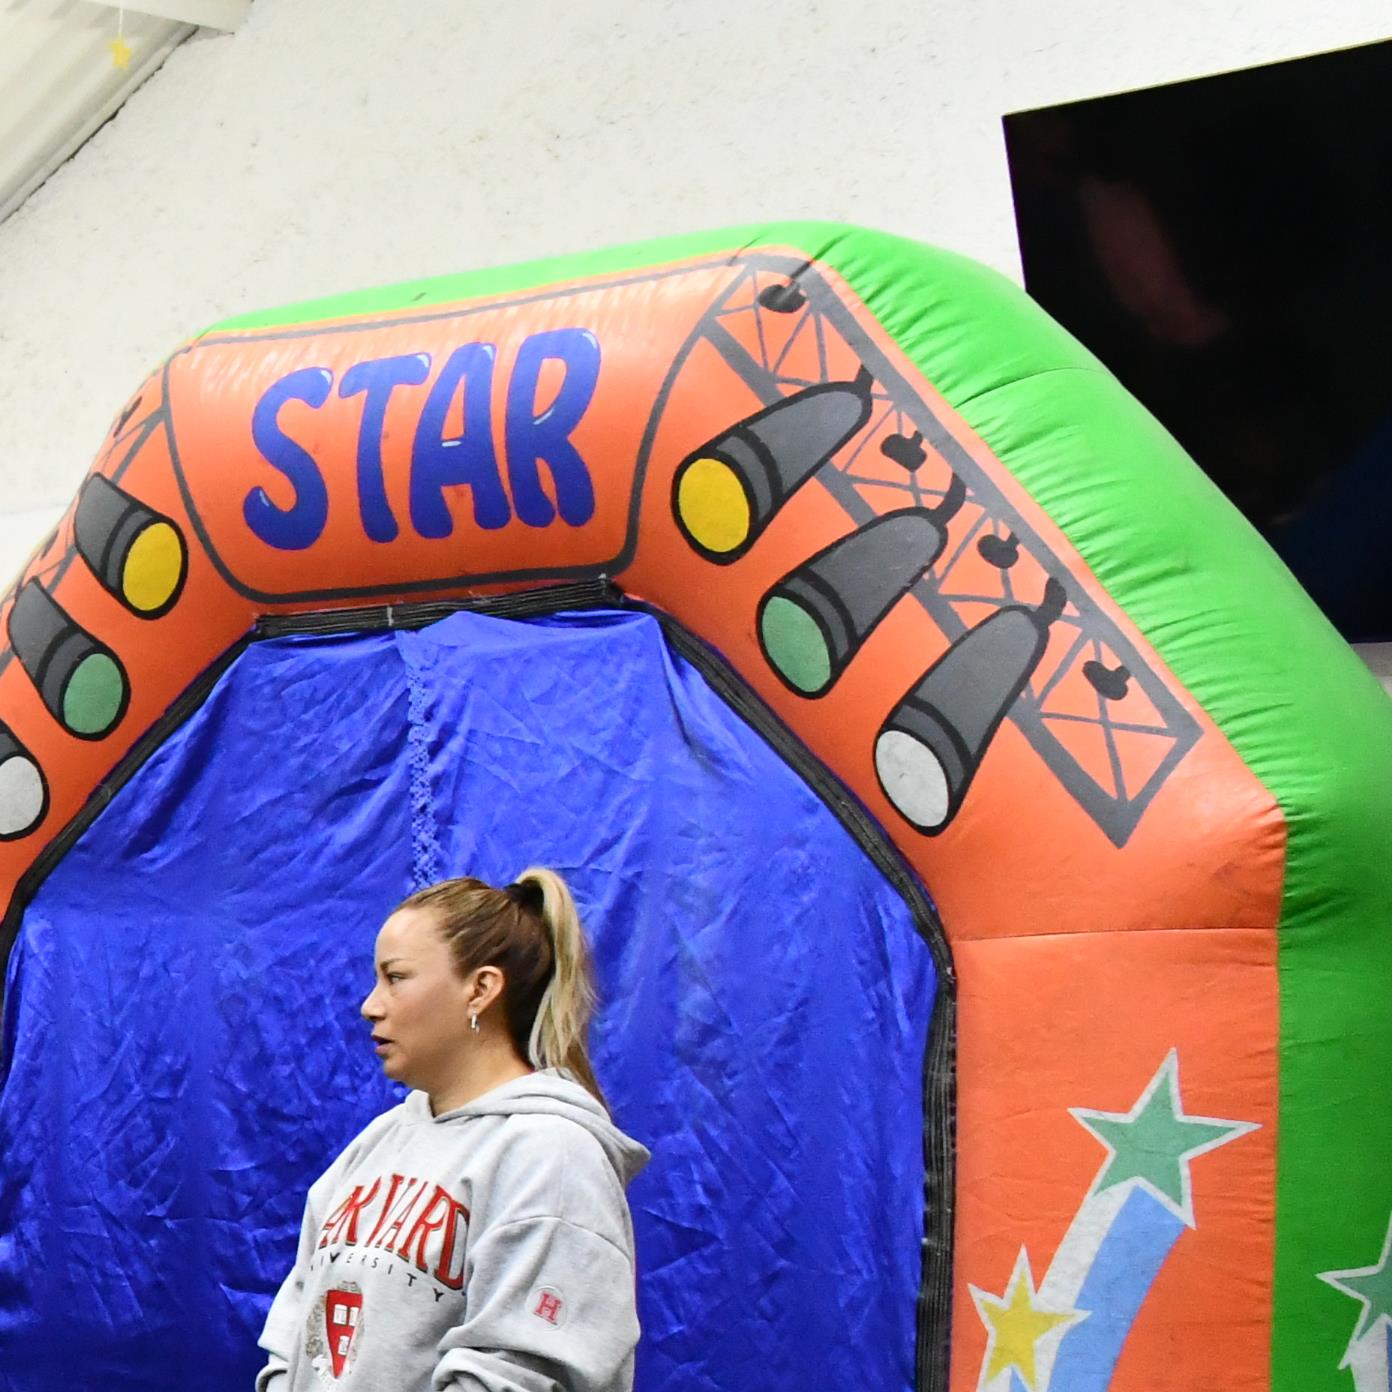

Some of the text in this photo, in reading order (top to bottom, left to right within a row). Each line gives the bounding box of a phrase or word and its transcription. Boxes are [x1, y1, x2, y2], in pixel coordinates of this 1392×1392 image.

[243, 328, 601, 550] STAR
[318, 1173, 470, 1290] ARVARD
[533, 1290, 562, 1325] H
